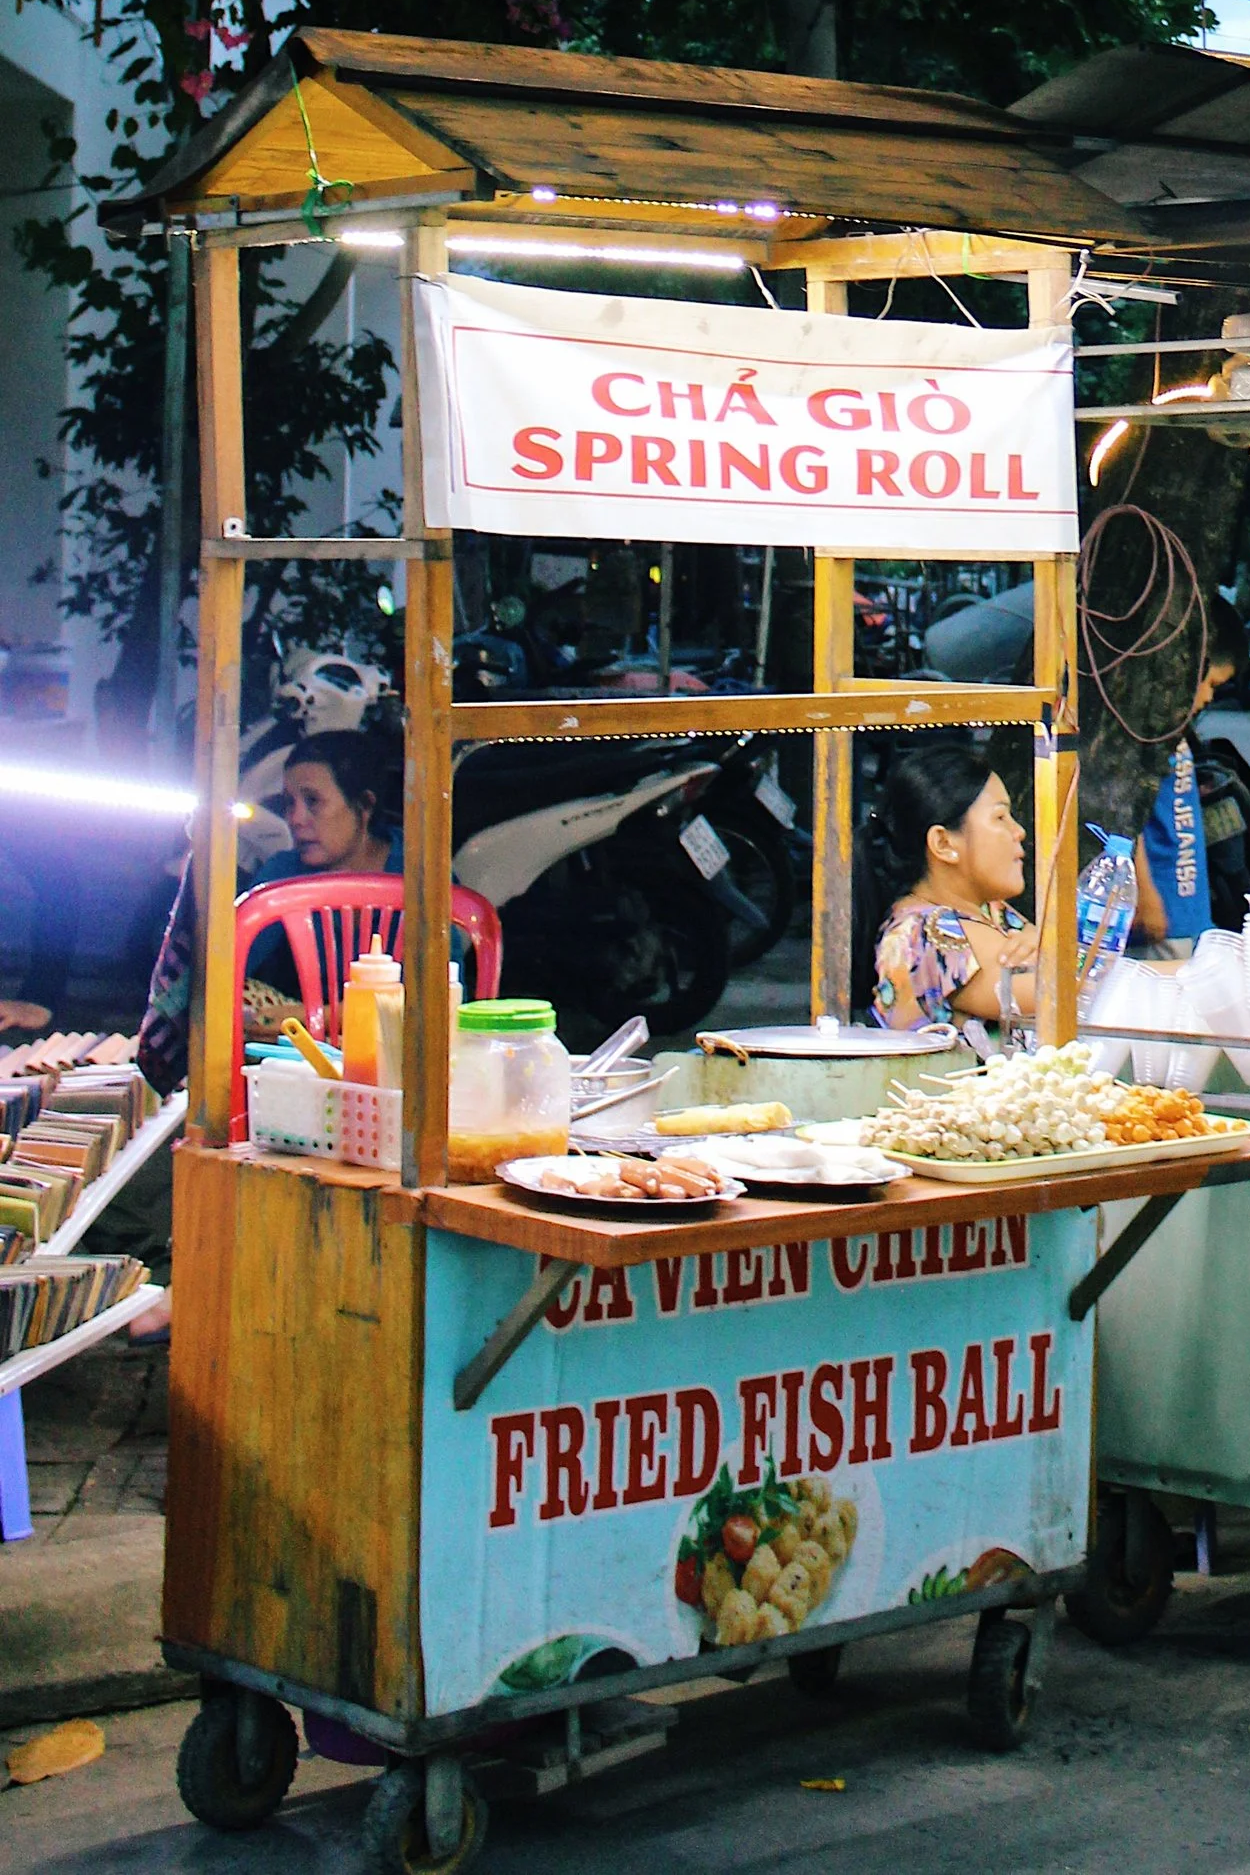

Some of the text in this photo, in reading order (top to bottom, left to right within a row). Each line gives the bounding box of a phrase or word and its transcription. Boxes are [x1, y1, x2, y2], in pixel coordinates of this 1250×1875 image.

[591, 368, 972, 435] CHẢ GIÒ
[511, 426, 1040, 501] SPRING ROLL
[489, 1334, 1061, 1529] FRIED FISH BALL
